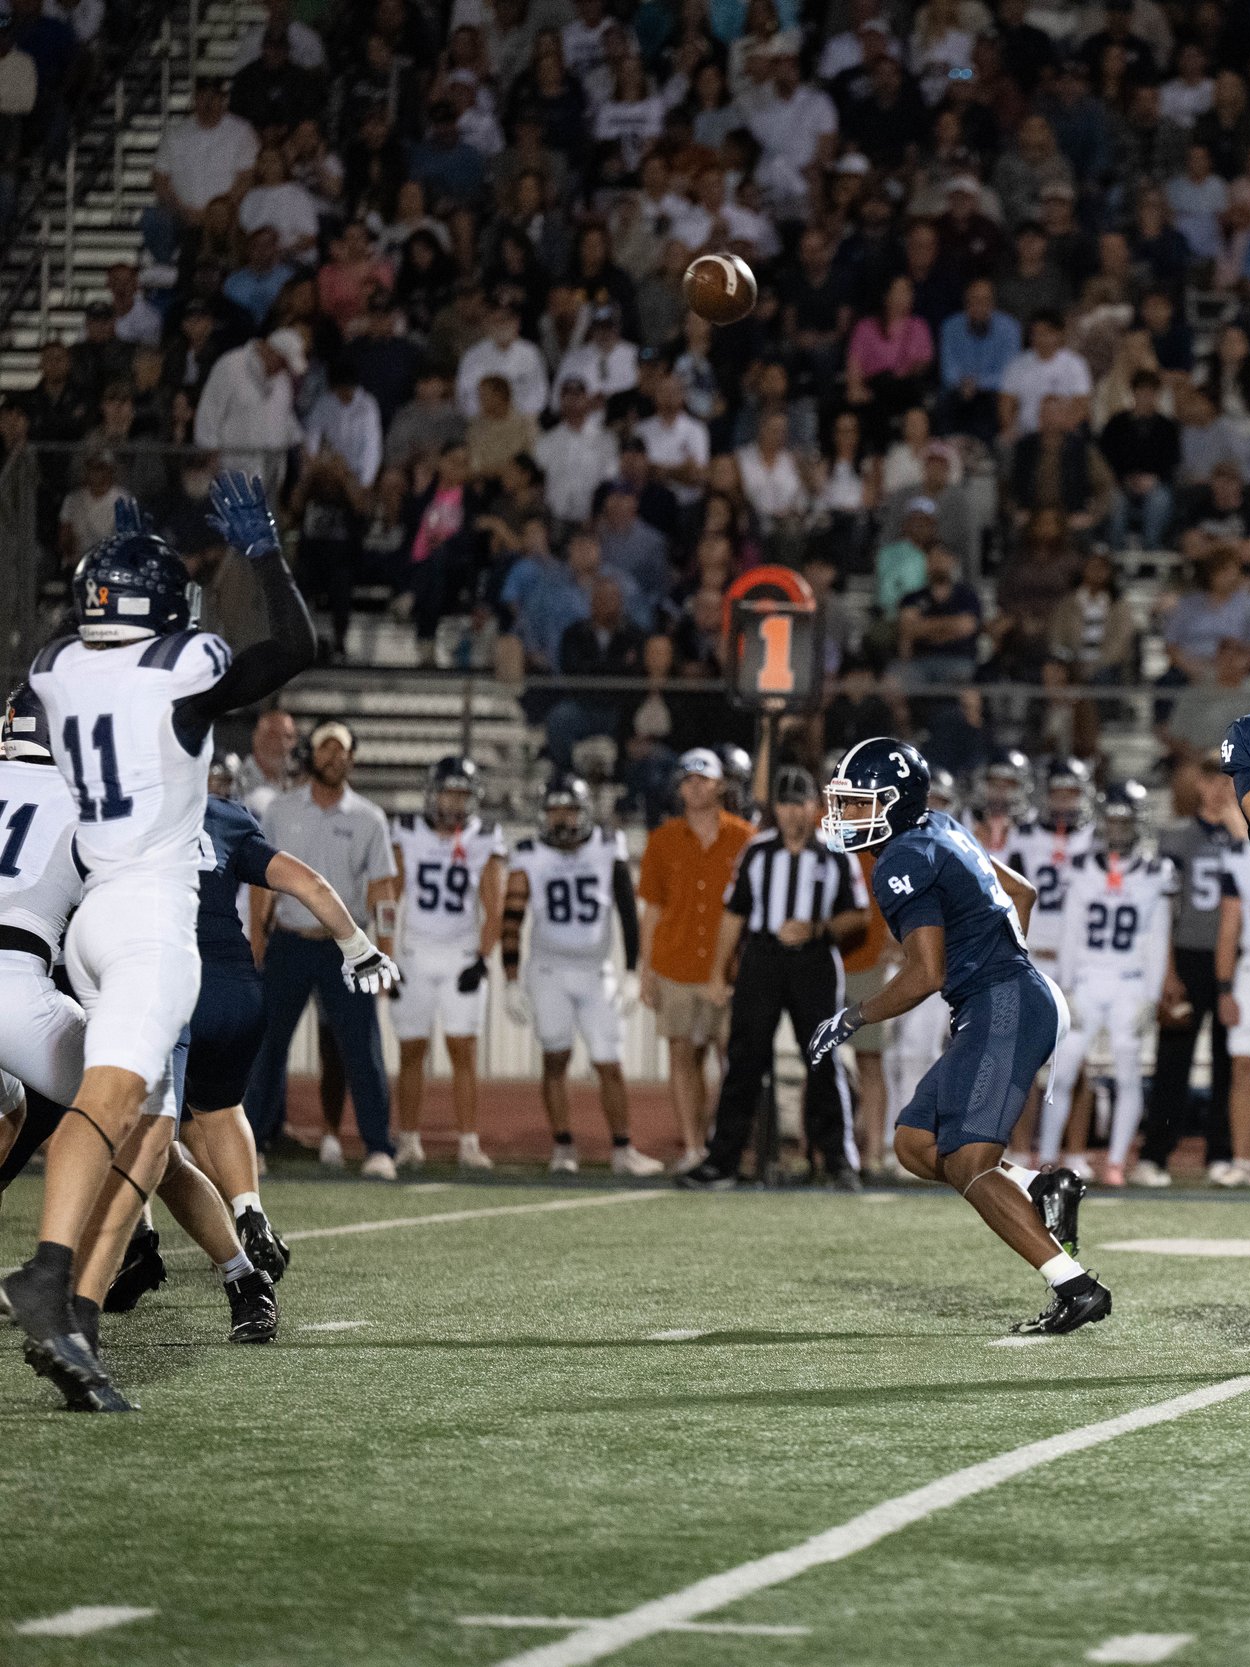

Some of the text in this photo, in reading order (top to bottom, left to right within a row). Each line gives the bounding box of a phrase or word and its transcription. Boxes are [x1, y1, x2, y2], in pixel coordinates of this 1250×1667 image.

[757, 614, 794, 692] 1
[63, 714, 133, 822] 11
[888, 752, 910, 778] 3
[0, 800, 38, 878] 1
[417, 862, 469, 914] 59
[546, 876, 600, 924] 85
[888, 874, 914, 895] SV
[1087, 902, 1138, 951] 28
